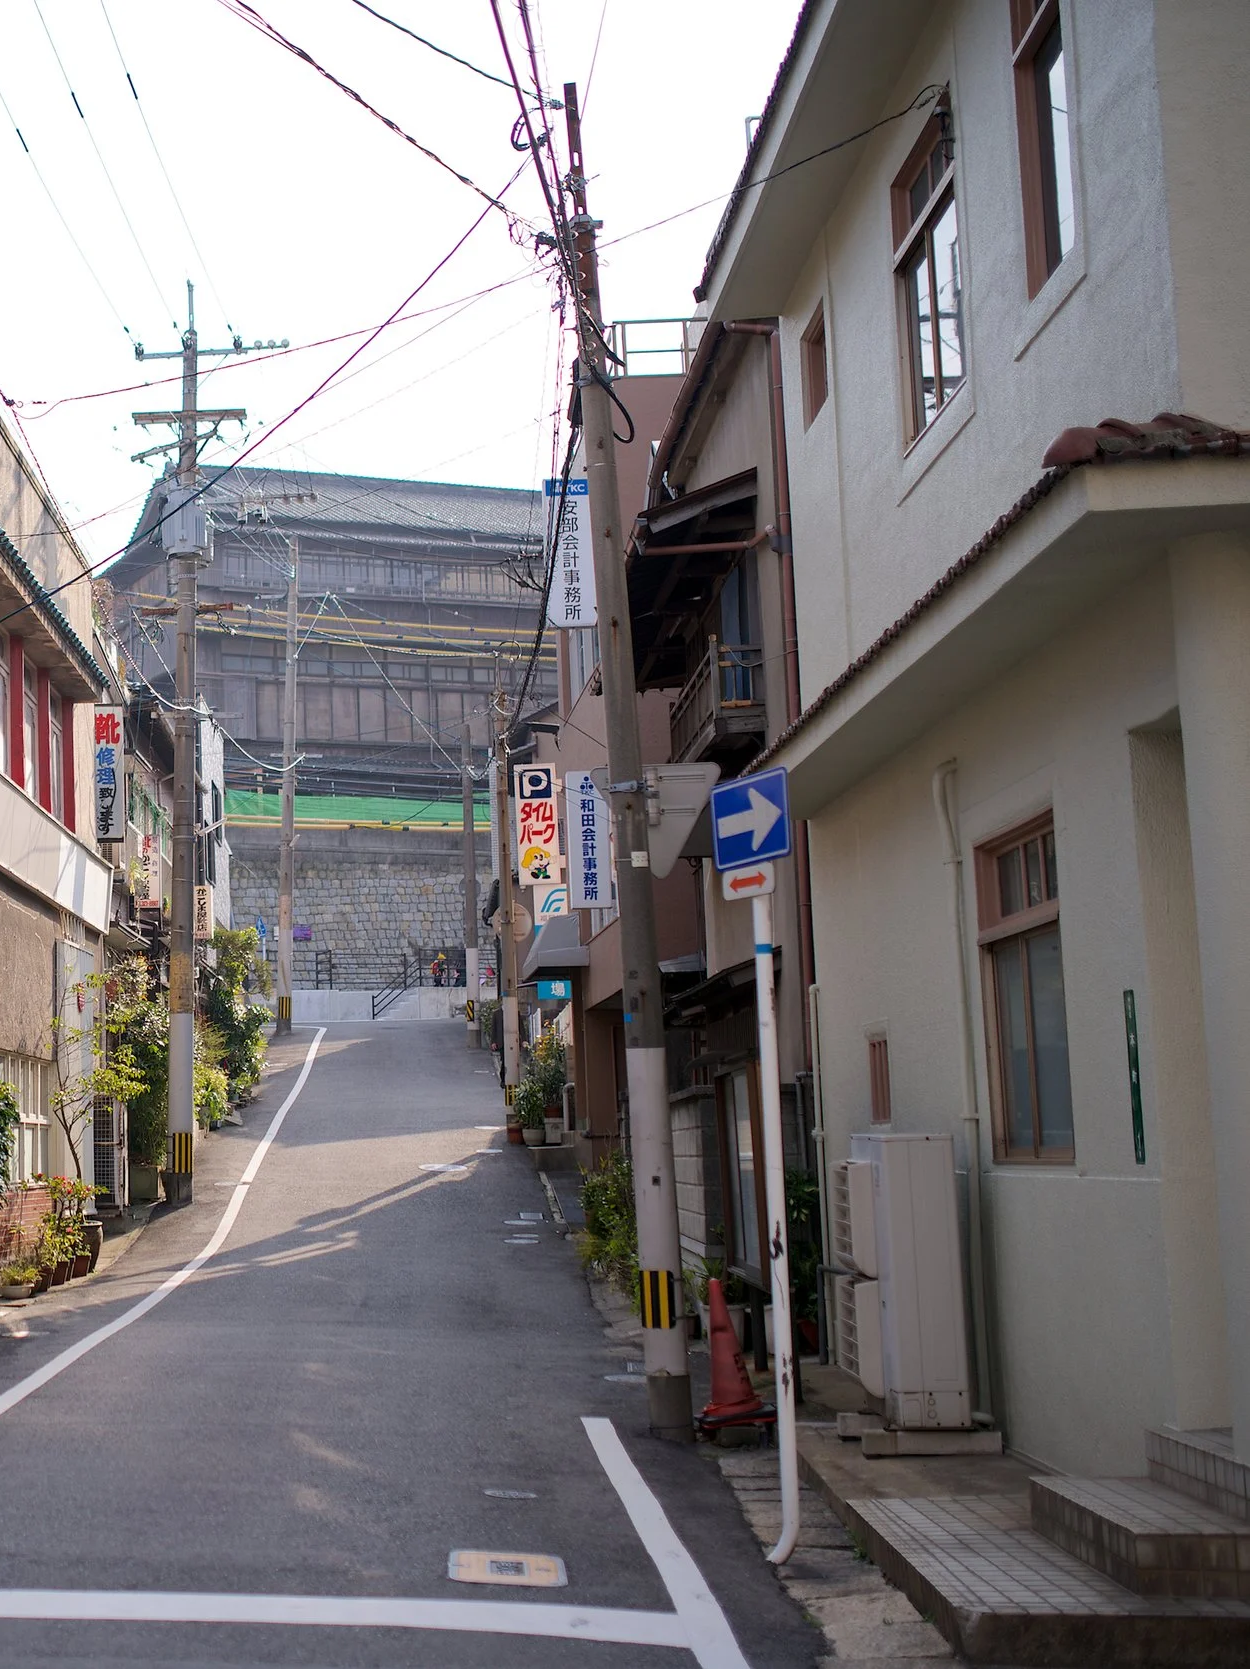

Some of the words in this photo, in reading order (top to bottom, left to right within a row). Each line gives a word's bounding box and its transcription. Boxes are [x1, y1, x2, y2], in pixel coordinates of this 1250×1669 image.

[562, 500, 582, 621] 安部会計事務所
[519, 823, 556, 845] パーク
[520, 802, 554, 823] タイム
[580, 799, 599, 901] 和田会計事務所
